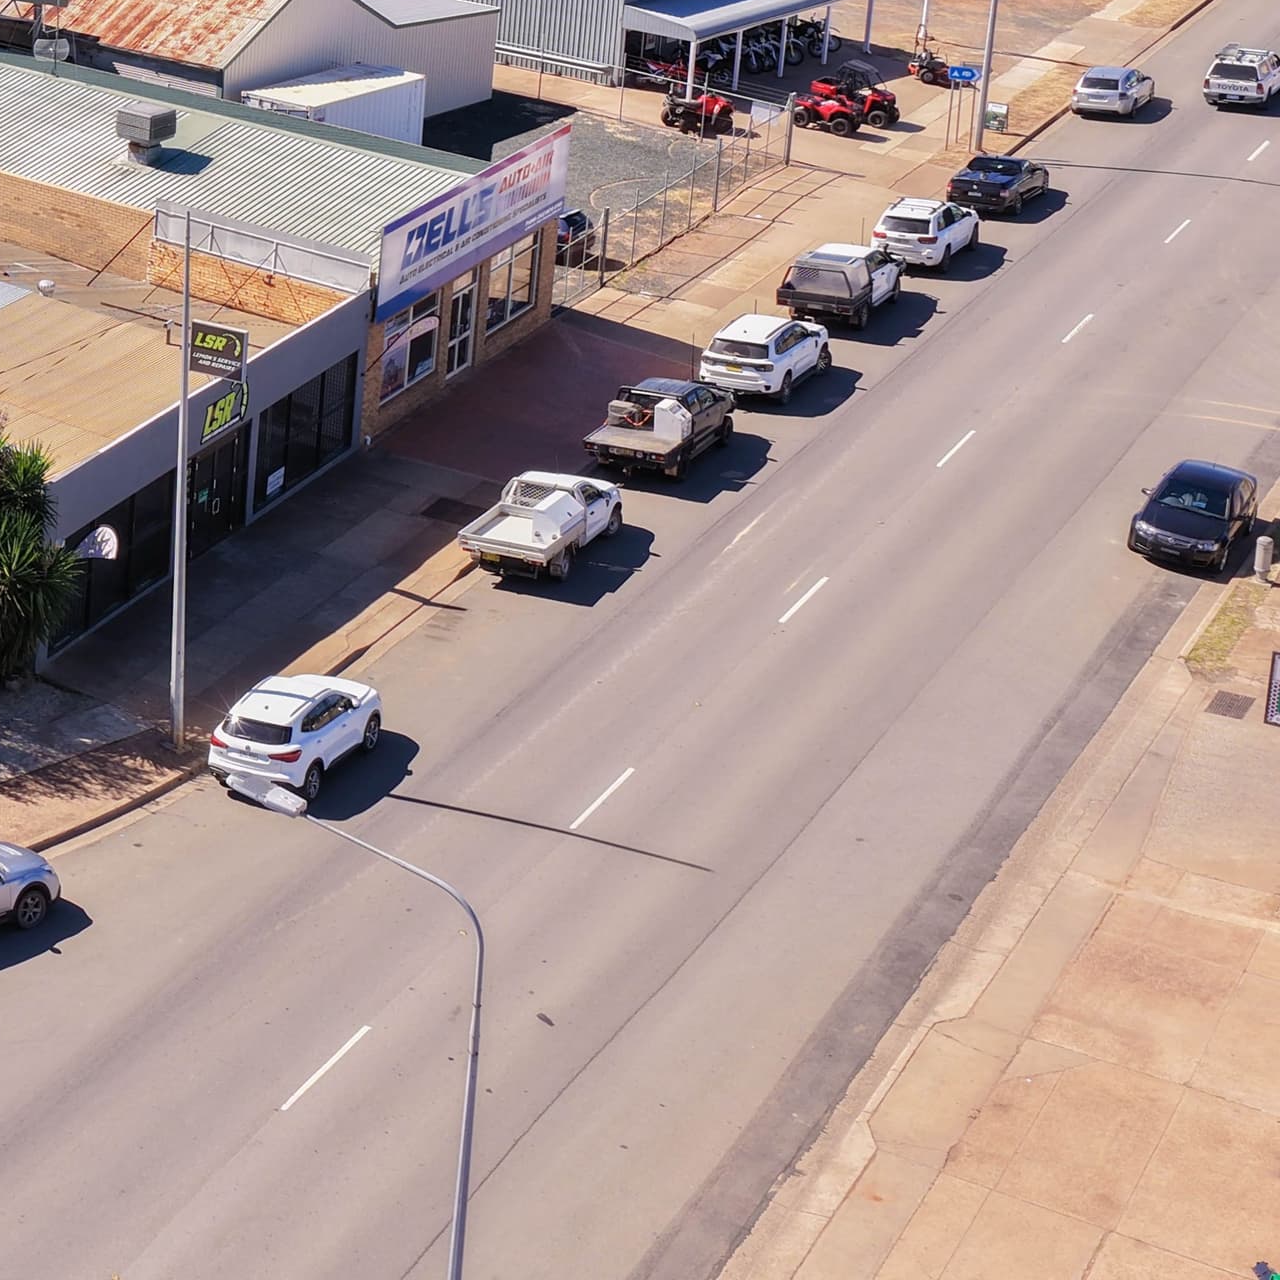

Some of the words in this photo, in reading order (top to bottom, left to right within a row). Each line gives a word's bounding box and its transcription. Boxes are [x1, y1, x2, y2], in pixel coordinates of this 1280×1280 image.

[1217, 83, 1249, 92] TOYOTA
[400, 269, 417, 285] AUTO
[418, 249, 454, 276] ELECTRICAL
[460, 237, 471, 249] AIR
[194, 332, 228, 351] LSR
[198, 359, 211, 367] AND
[212, 362, 235, 371] REPAIRS
[217, 356, 241, 367] SERVICE
[203, 391, 237, 437] LSR
